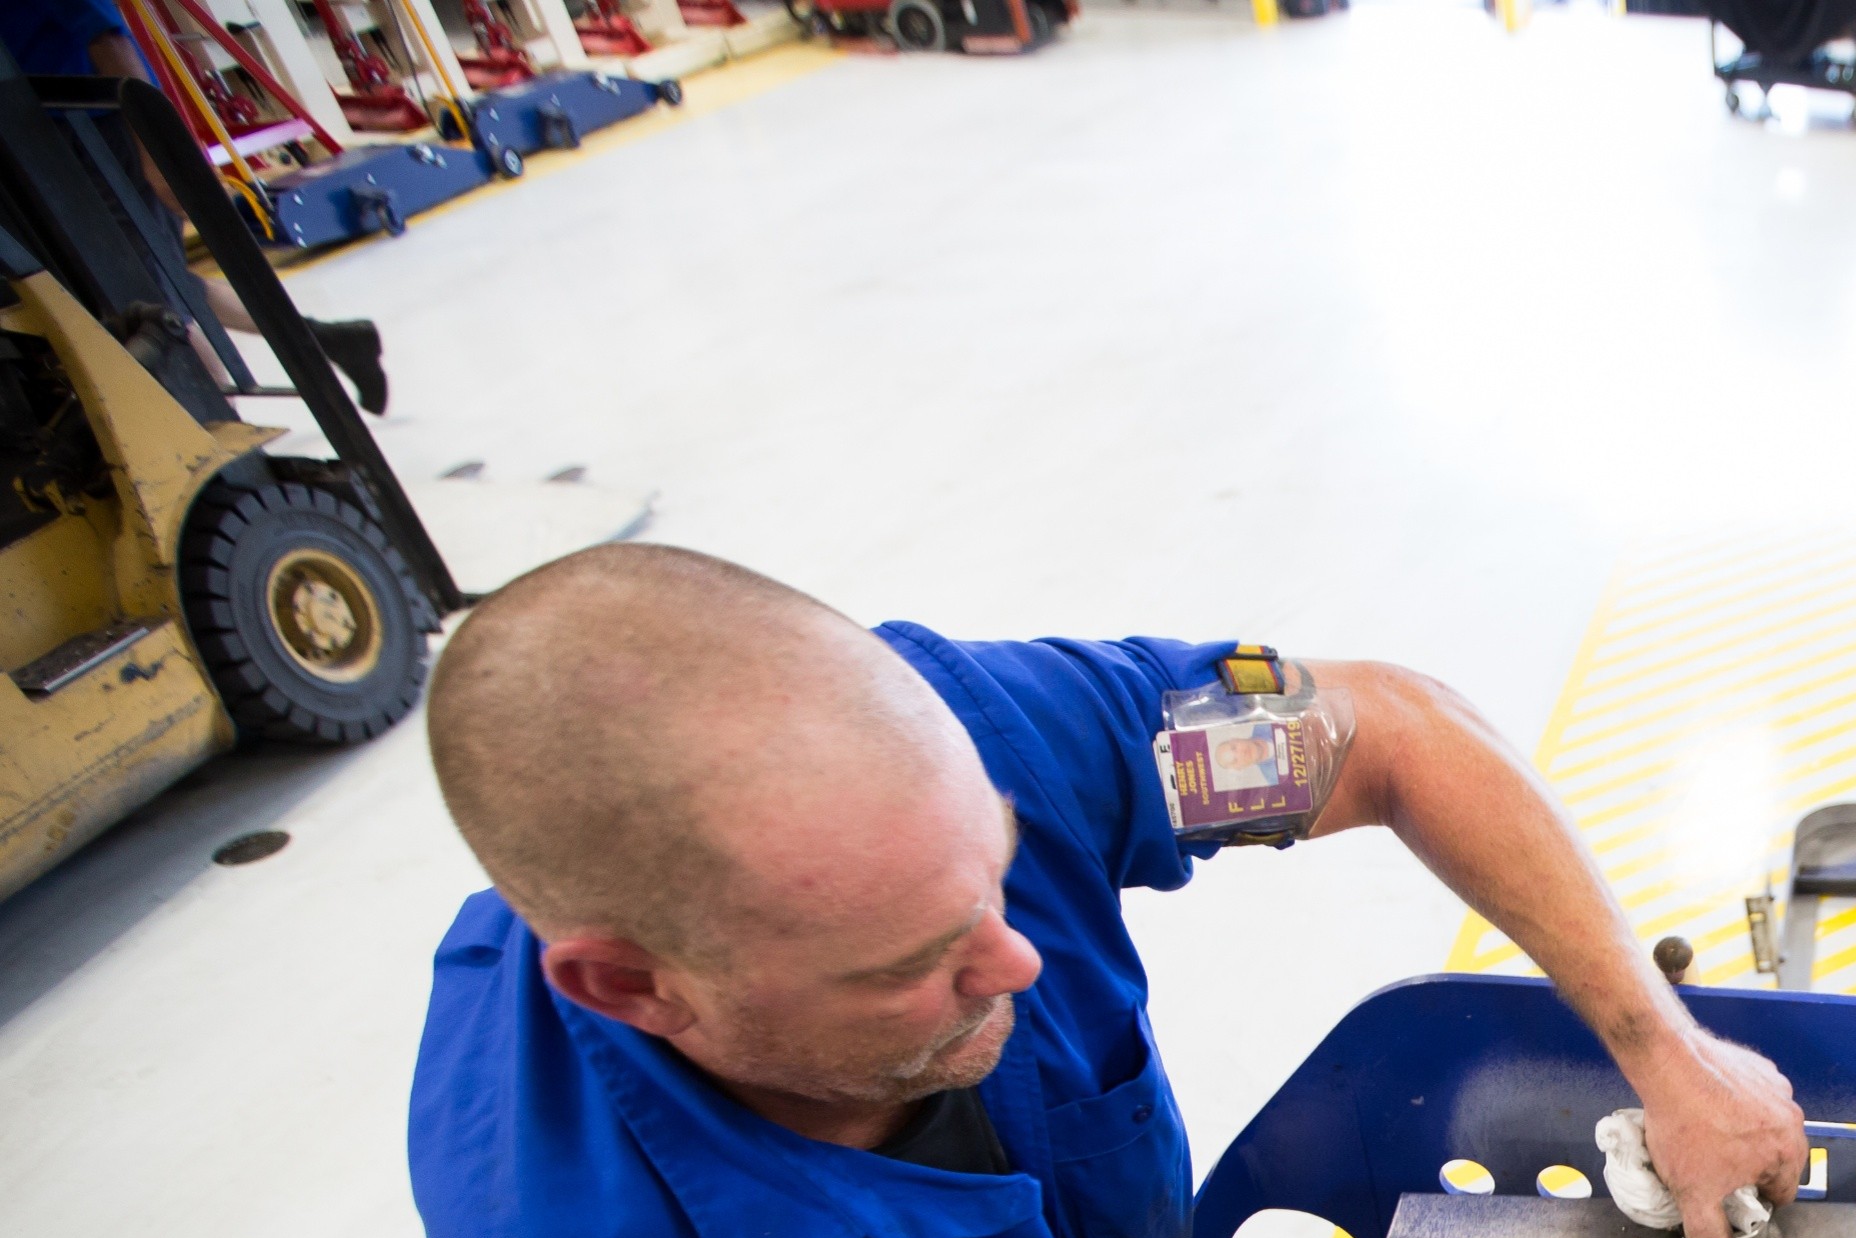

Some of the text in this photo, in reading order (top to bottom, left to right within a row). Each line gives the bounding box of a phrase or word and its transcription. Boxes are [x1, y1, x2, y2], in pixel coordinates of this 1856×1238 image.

[1286, 720, 1309, 788] 12/27/19
[1175, 760, 1189, 796] HENRY
[1185, 760, 1198, 795] JONES
[1195, 751, 1210, 806] SOUTHWEST
